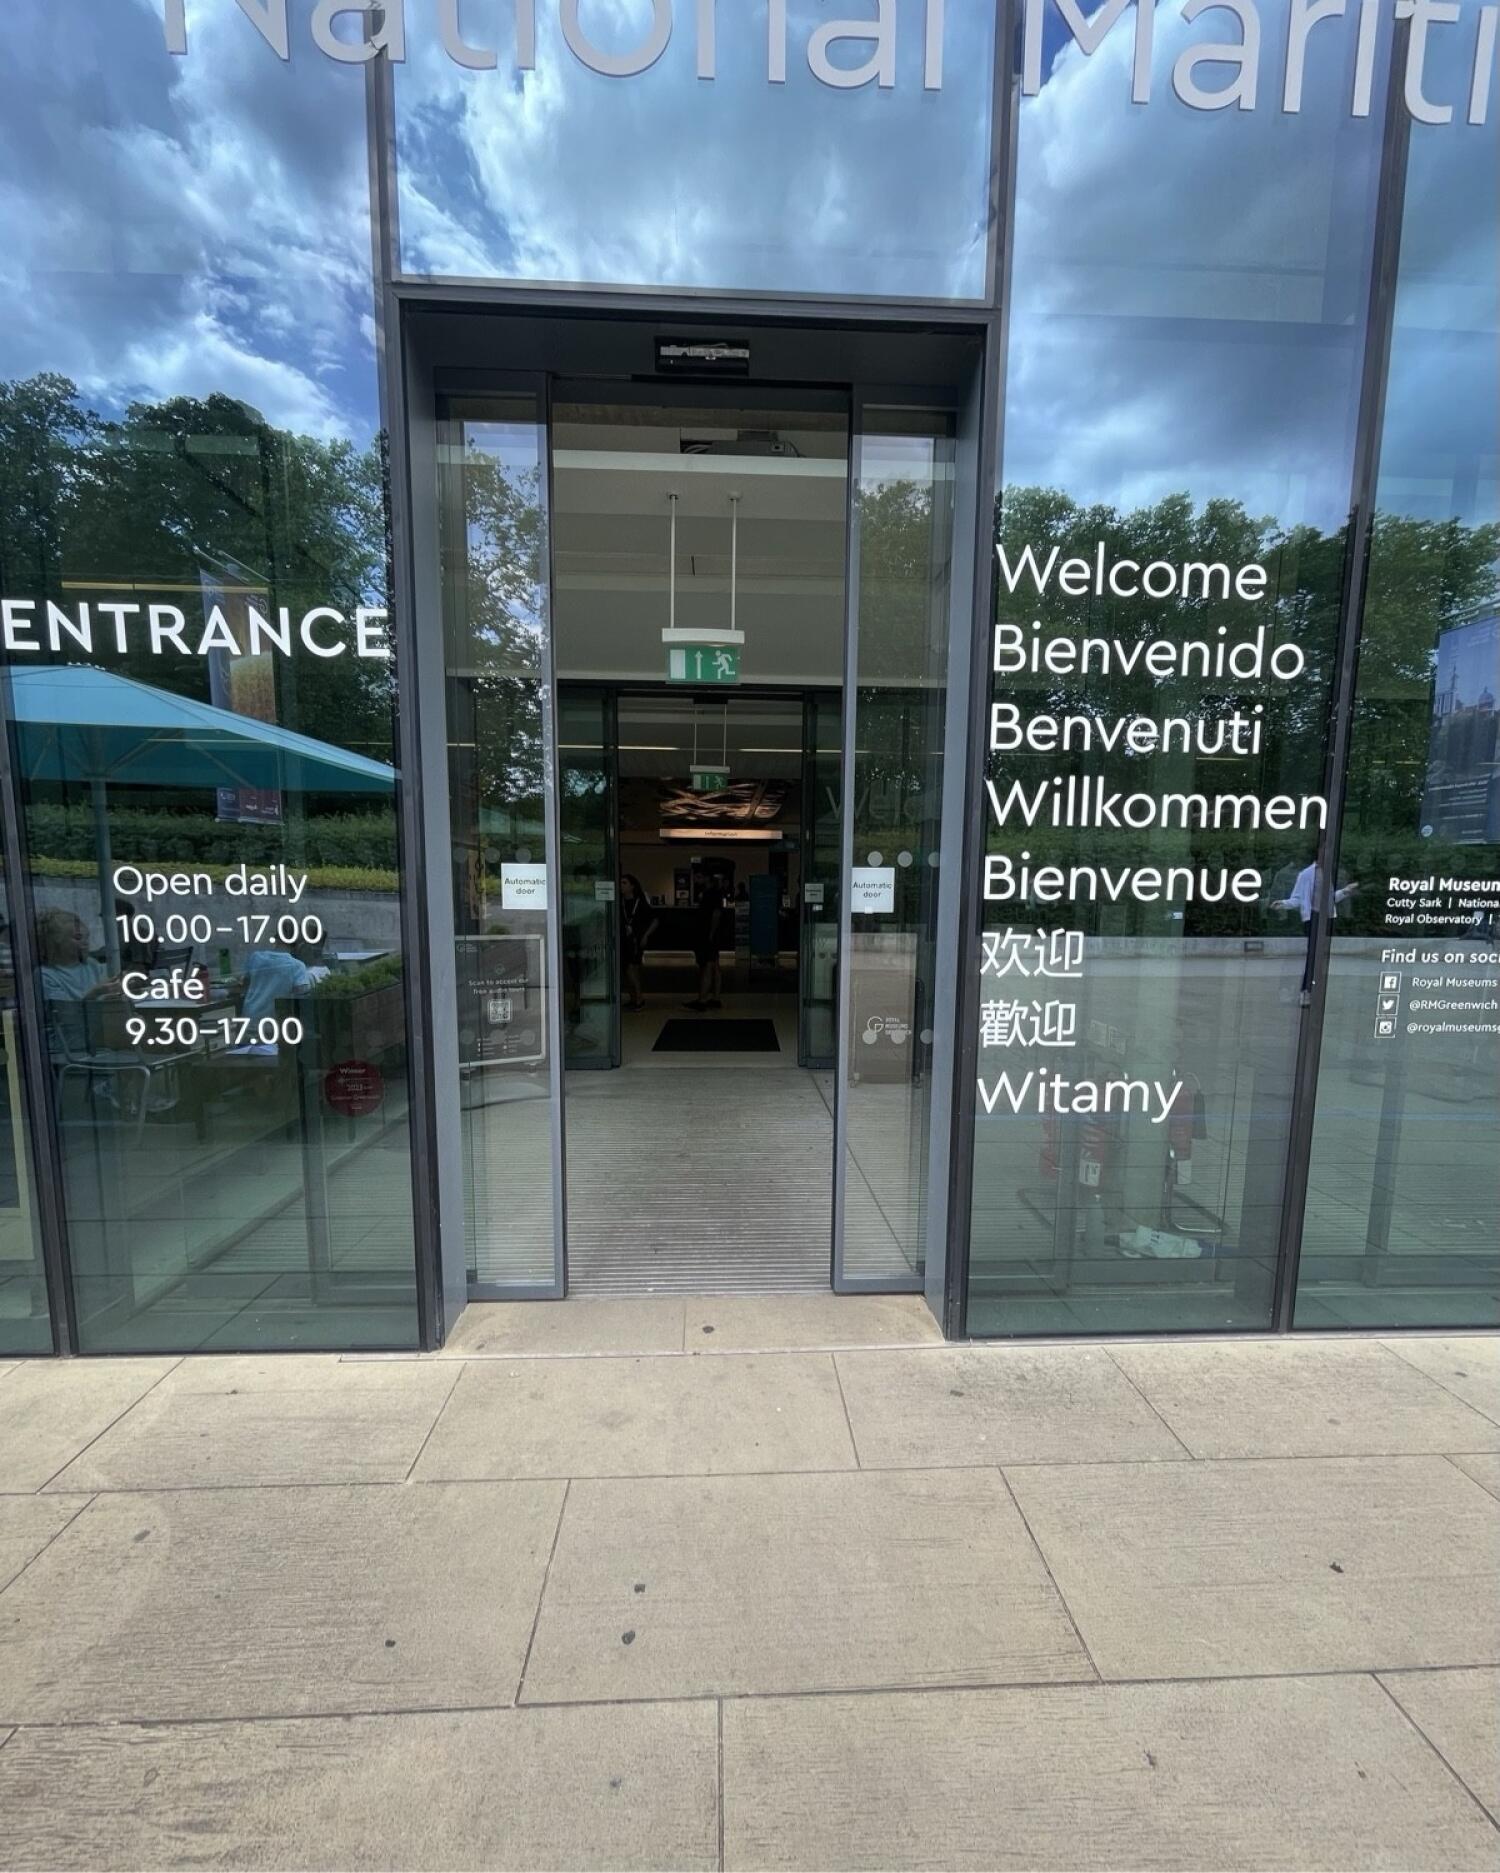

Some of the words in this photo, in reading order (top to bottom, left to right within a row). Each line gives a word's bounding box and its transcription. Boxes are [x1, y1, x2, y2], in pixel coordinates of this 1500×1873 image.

[995, 541, 1267, 601] Welcome
[1, 599, 391, 658] ENTRANCE
[993, 620, 1304, 680] Bienvenido
[990, 703, 1263, 755] Benvenuti
[985, 775, 1328, 830] Willkommen
[112, 865, 213, 902] Open
[224, 864, 308, 904] daily
[504, 877, 546, 886] Automatic
[515, 887, 535, 895] door
[853, 881, 892, 890] Automatic
[983, 851, 1262, 902] Bienvenue
[1389, 876, 1434, 894] Royal
[1385, 913, 1415, 925] Royal
[1417, 914, 1482, 926] Observatory
[1386, 897, 1417, 909] Cutty
[1419, 897, 1442, 908] Sark
[980, 927, 1084, 978] 欢迎
[1381, 948, 1416, 963] Find
[1421, 952, 1439, 963] us
[1444, 952, 1465, 964] on
[121, 968, 204, 1000] Café
[1412, 976, 1443, 990] Royal
[1446, 977, 1498, 988] Museums
[1409, 999, 1498, 1011] @RMGreenwich
[980, 1000, 1076, 1048] 歡迎
[977, 1067, 1183, 1124] Witamy
